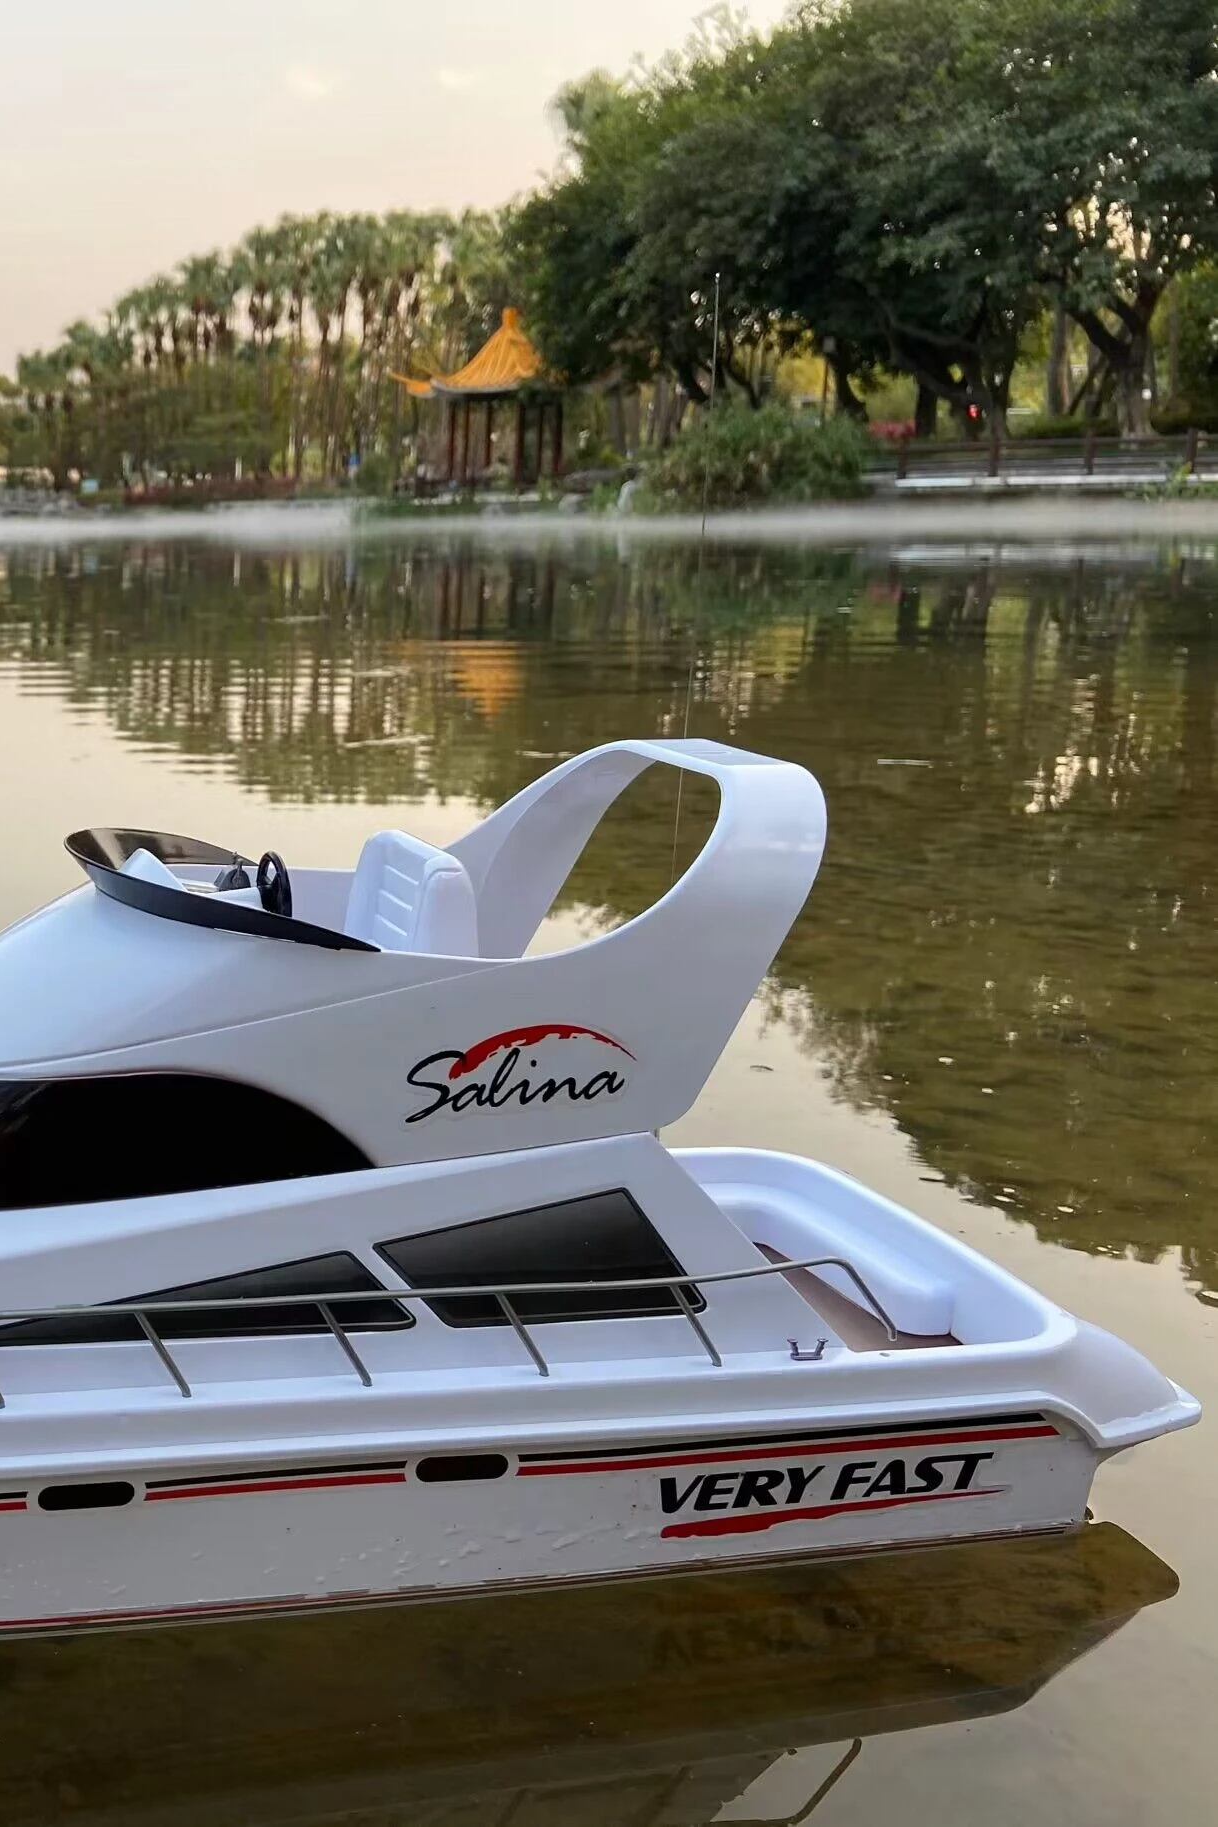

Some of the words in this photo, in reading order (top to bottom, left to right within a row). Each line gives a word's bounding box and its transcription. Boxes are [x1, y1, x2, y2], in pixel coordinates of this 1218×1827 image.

[405, 1047, 625, 1123] Salina
[659, 1465, 826, 1514] VERY
[830, 1451, 994, 1501] FAST
